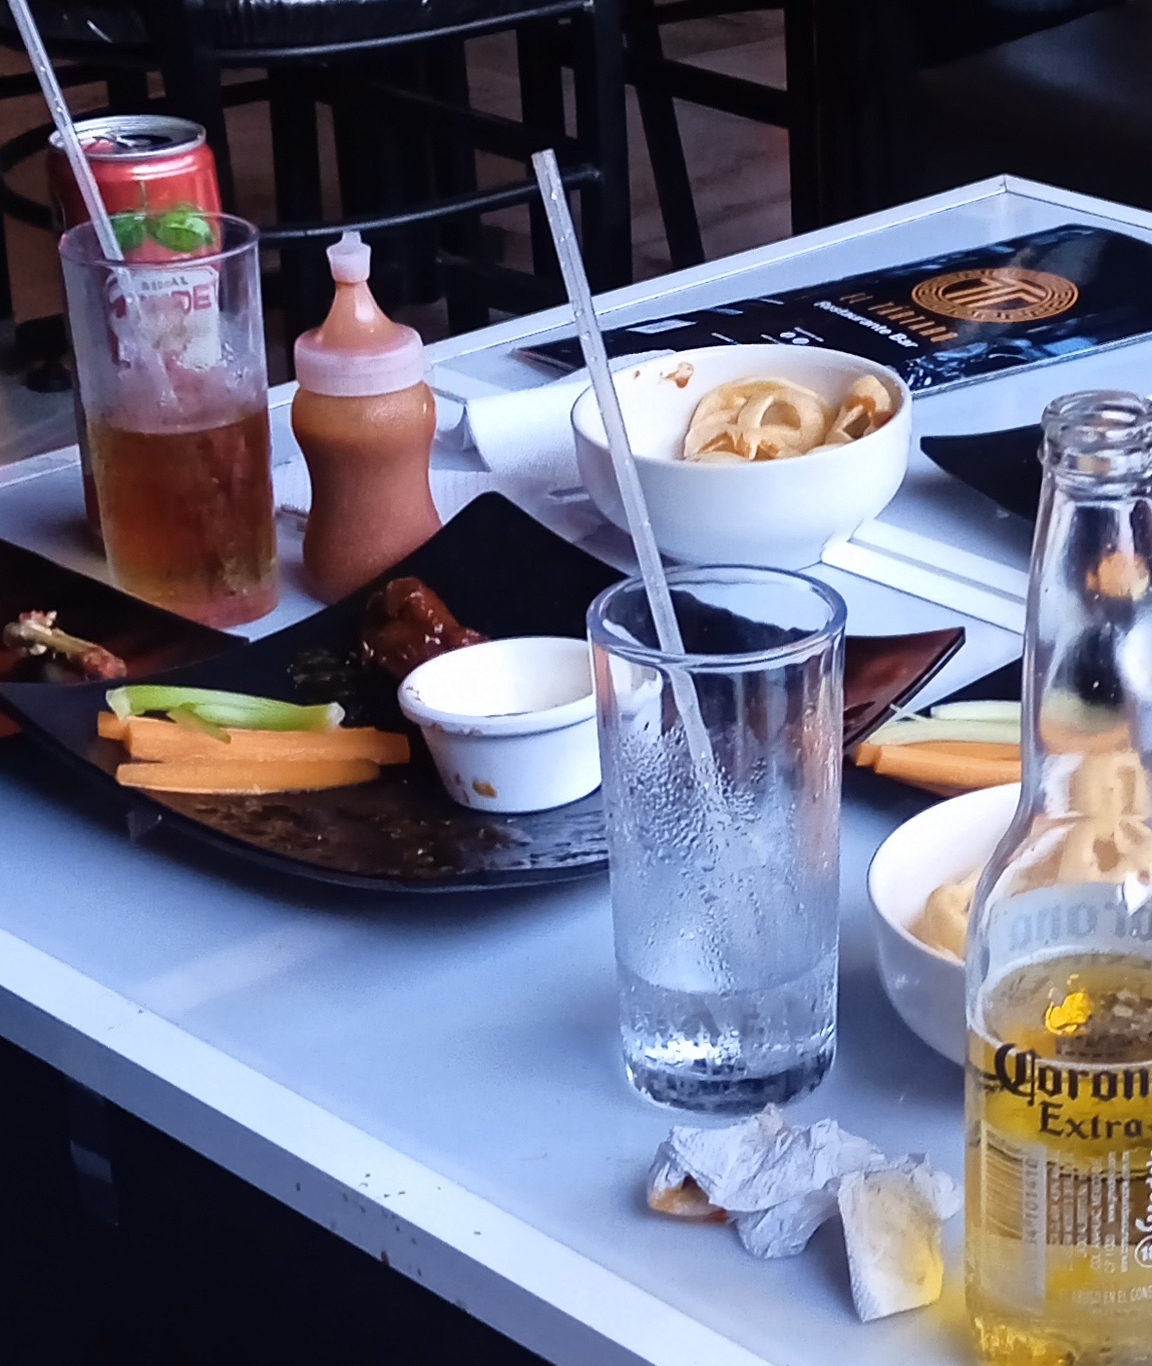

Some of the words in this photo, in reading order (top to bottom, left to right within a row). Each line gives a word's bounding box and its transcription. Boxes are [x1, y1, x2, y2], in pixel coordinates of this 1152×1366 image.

[813, 300, 892, 335] Restaurante
[889, 333, 918, 348] Bar
[1039, 1100, 1144, 1140] Extra
